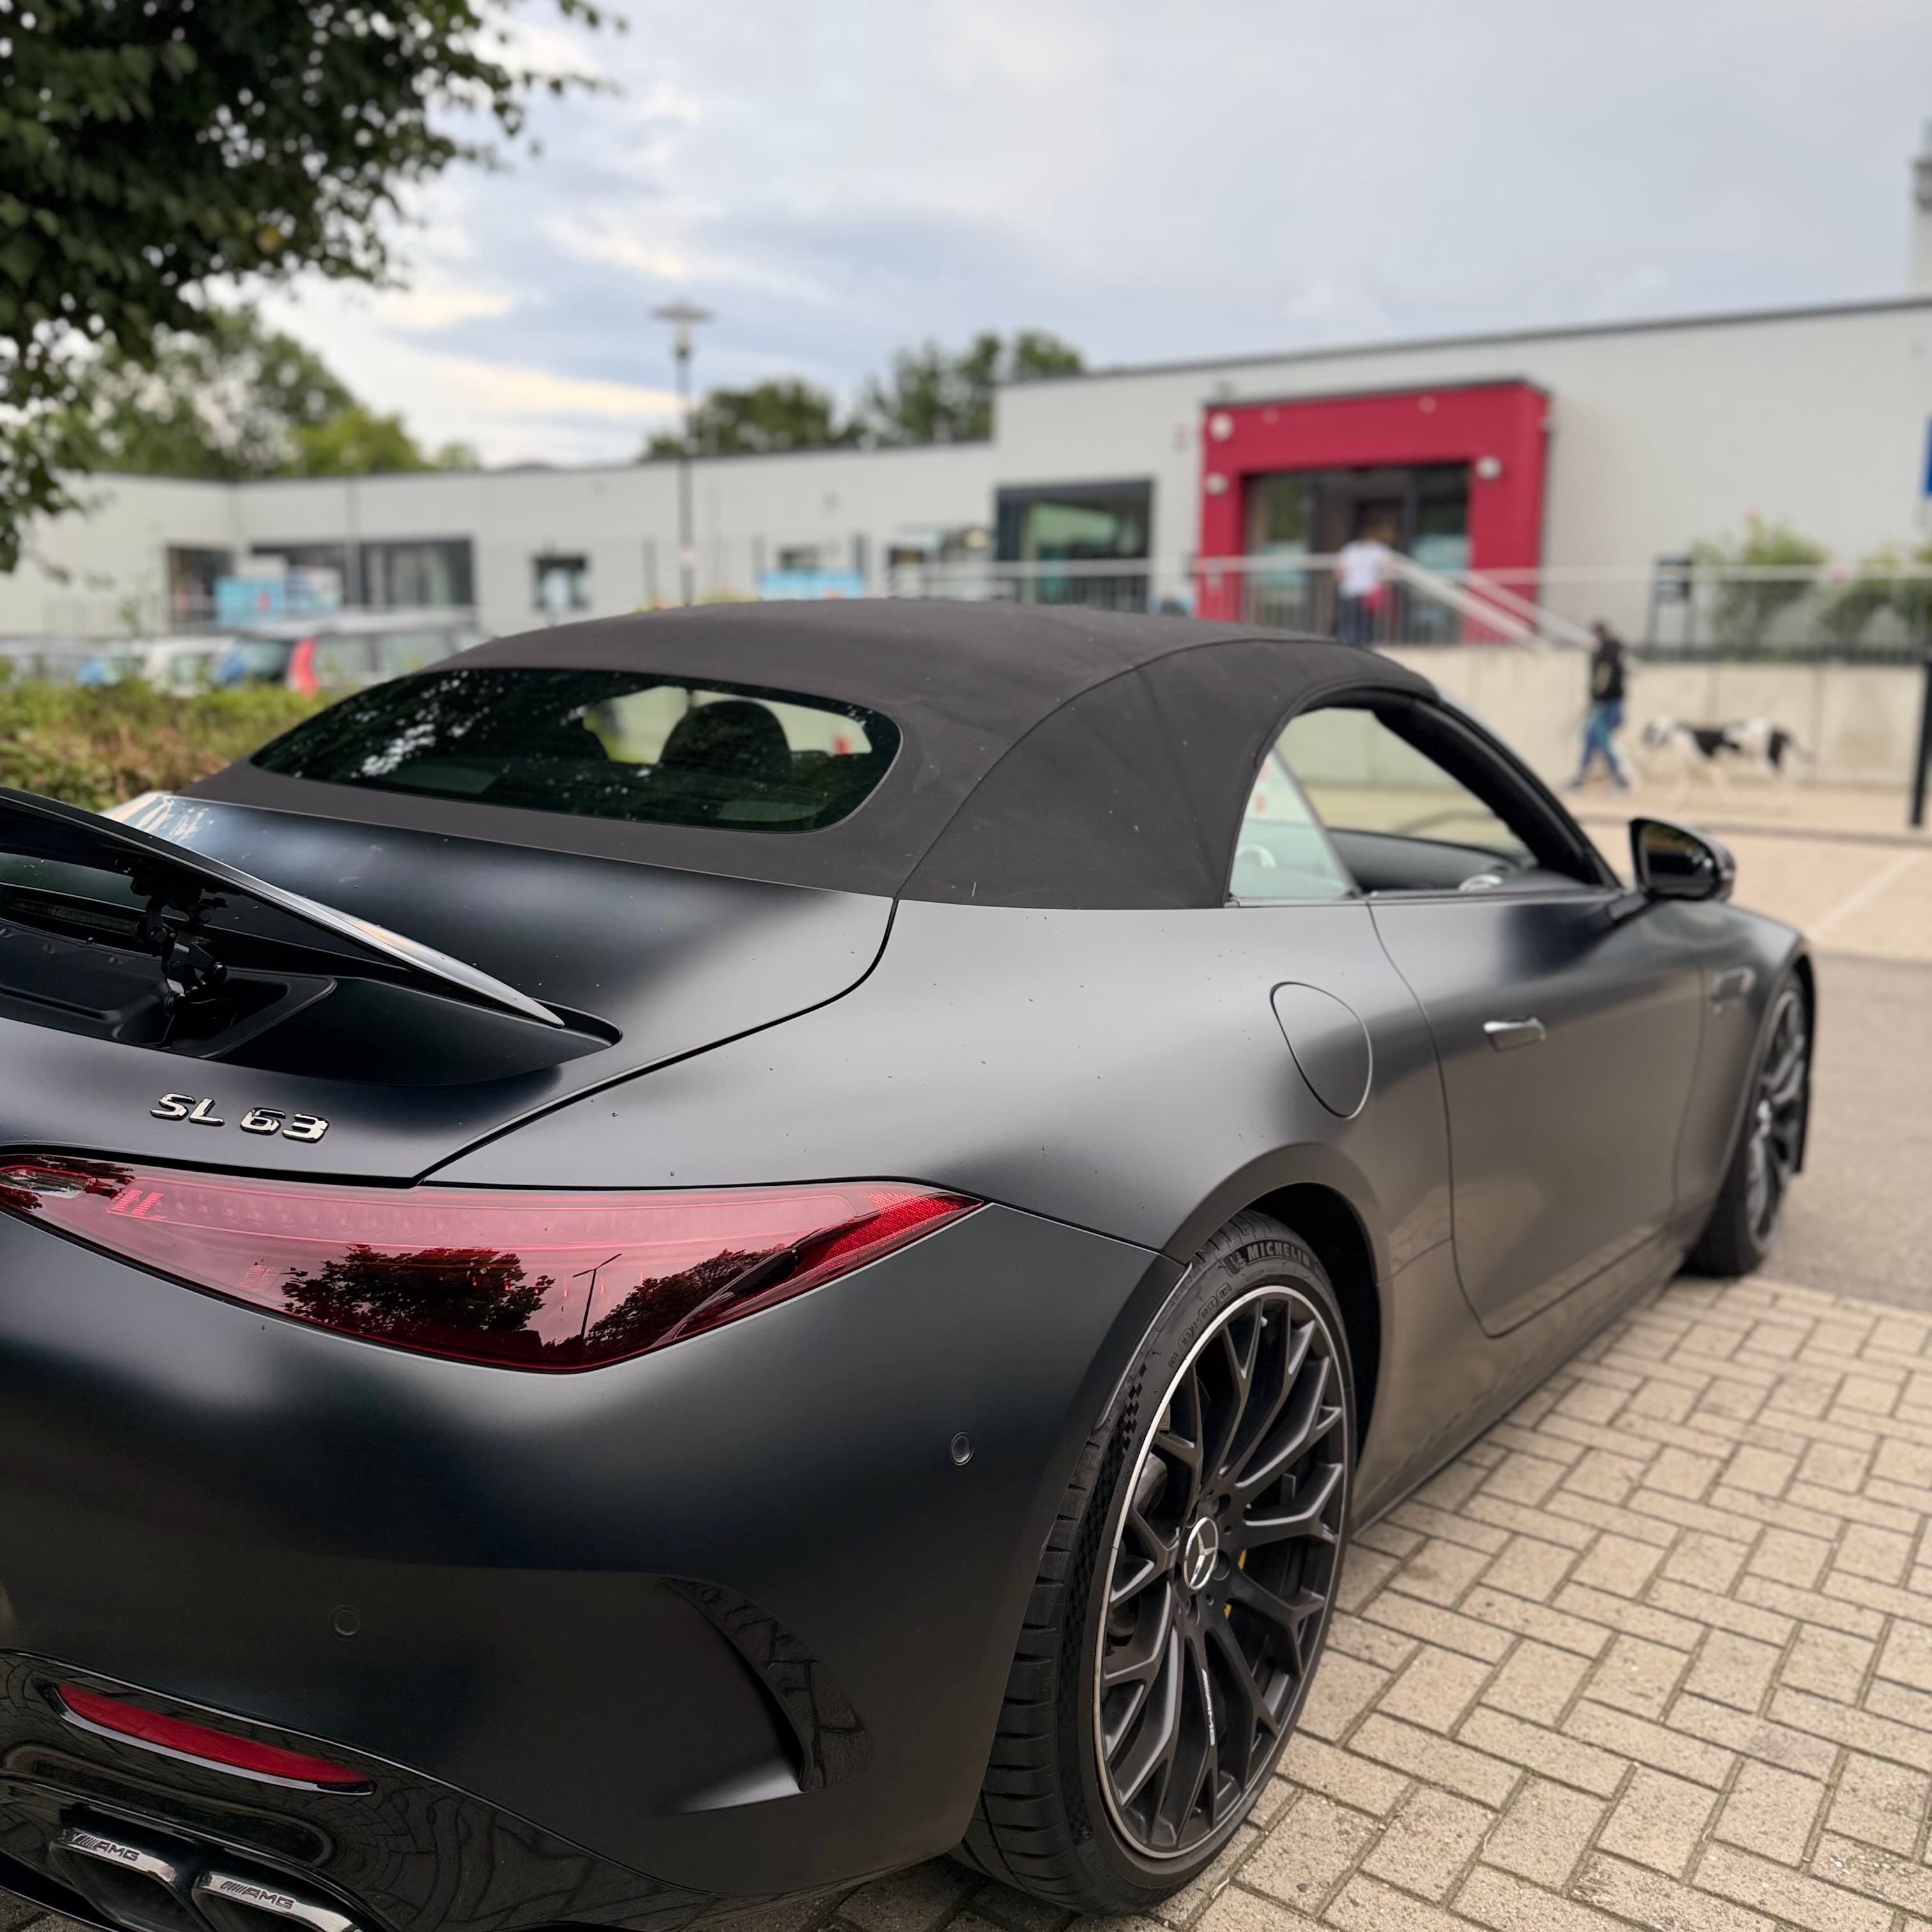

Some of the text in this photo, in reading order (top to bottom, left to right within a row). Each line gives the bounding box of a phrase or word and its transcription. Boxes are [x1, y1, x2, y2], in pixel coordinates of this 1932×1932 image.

[150, 1092, 330, 1144] SL 63
[1246, 1241, 1310, 1267] MICHELIN
[93, 1841, 140, 1861] AMG
[243, 1889, 295, 1910] AMG
